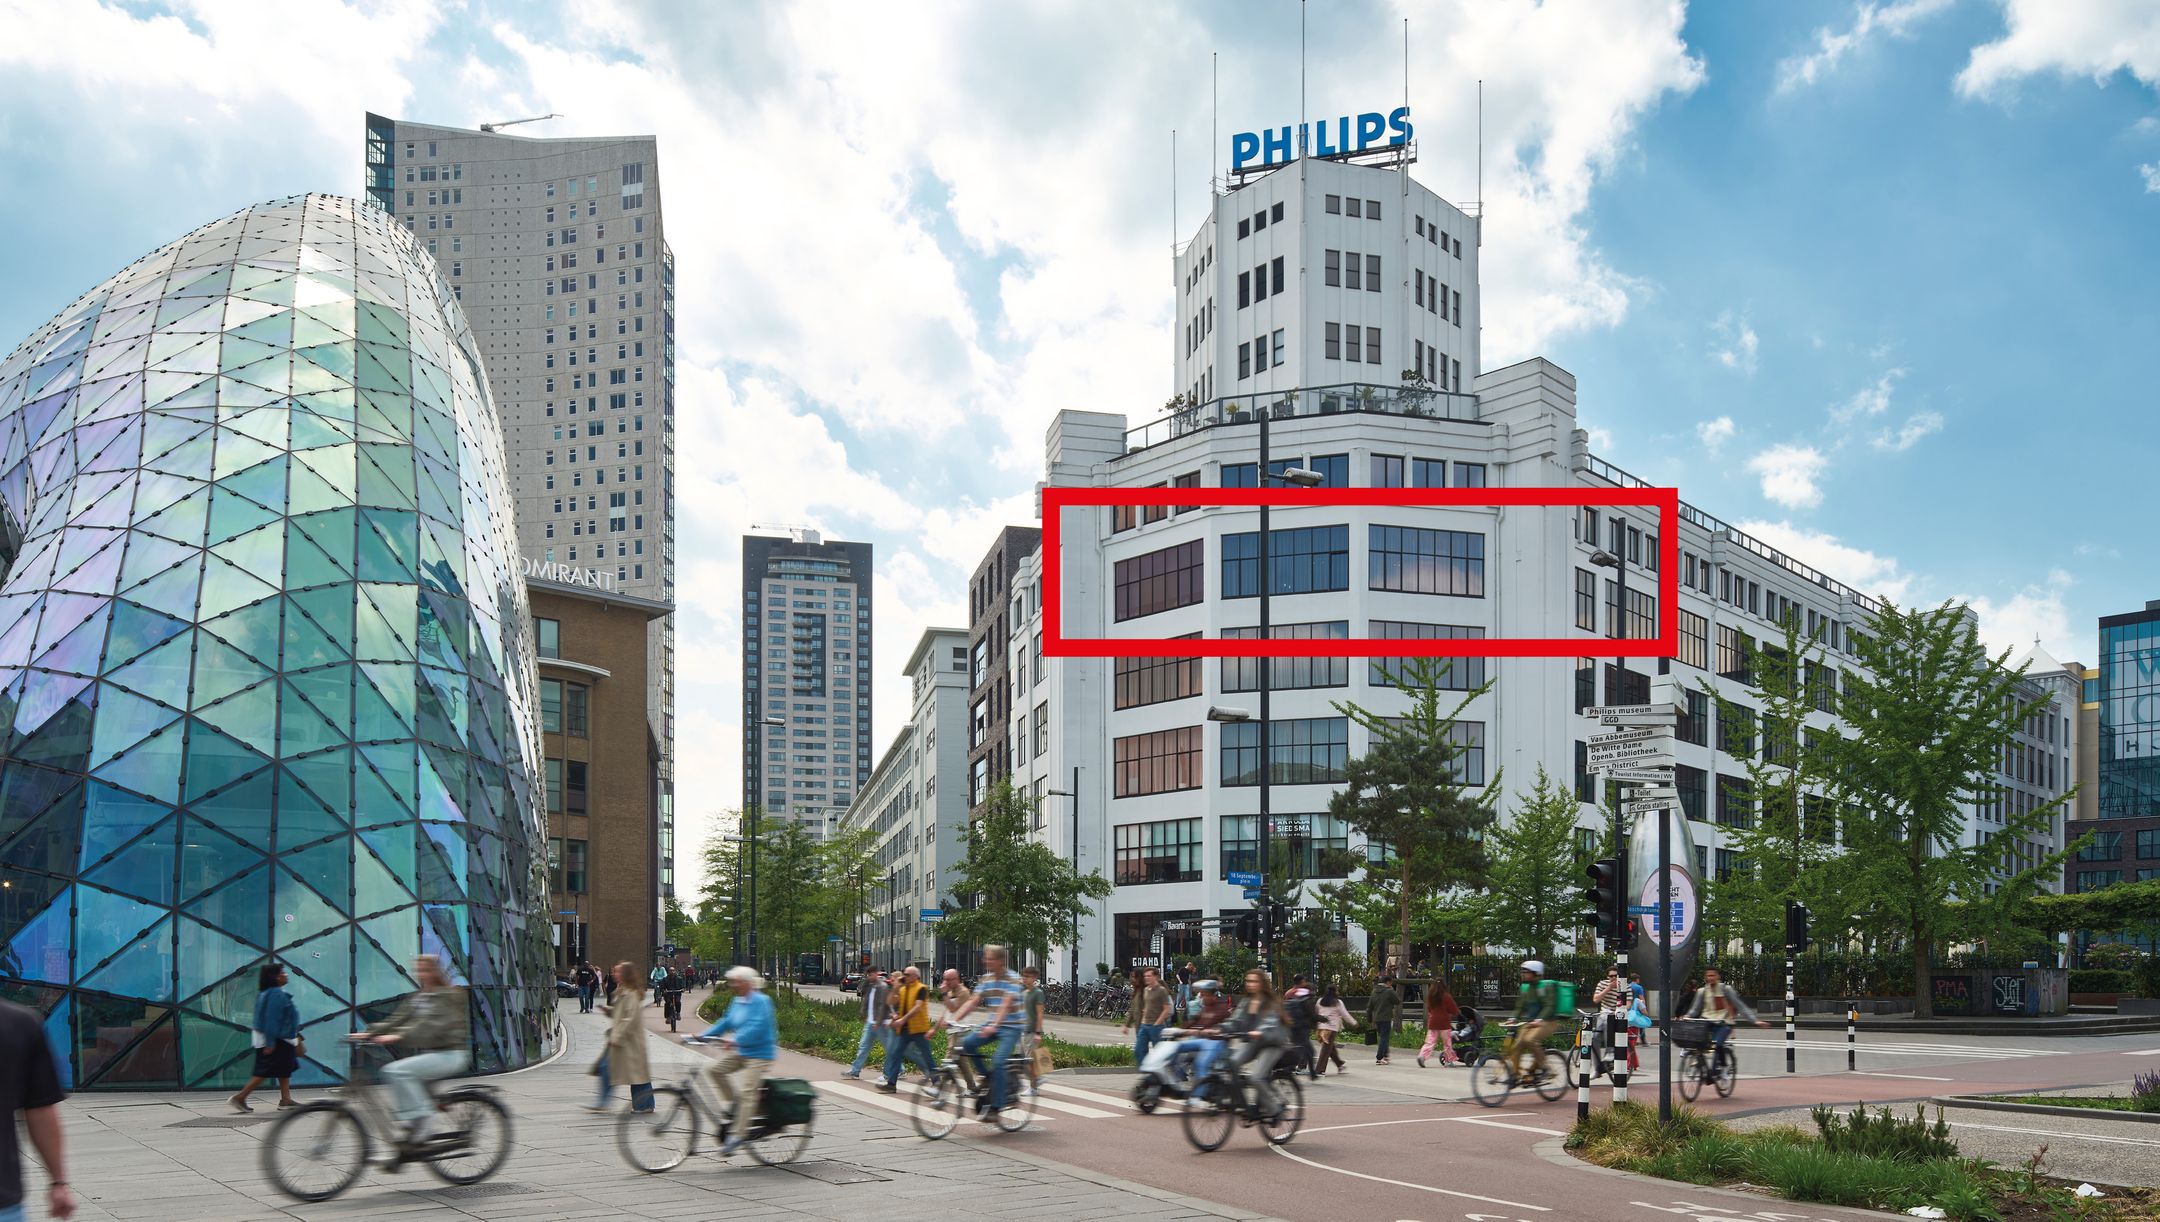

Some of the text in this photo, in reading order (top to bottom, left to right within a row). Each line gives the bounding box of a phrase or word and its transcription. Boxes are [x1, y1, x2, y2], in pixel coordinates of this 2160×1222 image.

[1232, 106, 1414, 170] PHILIPS
[1605, 730, 1653, 741] Abbemuseum
[1591, 747, 1658, 762] Openb. Bibliotheek
[1601, 744, 1621, 752] Witte
